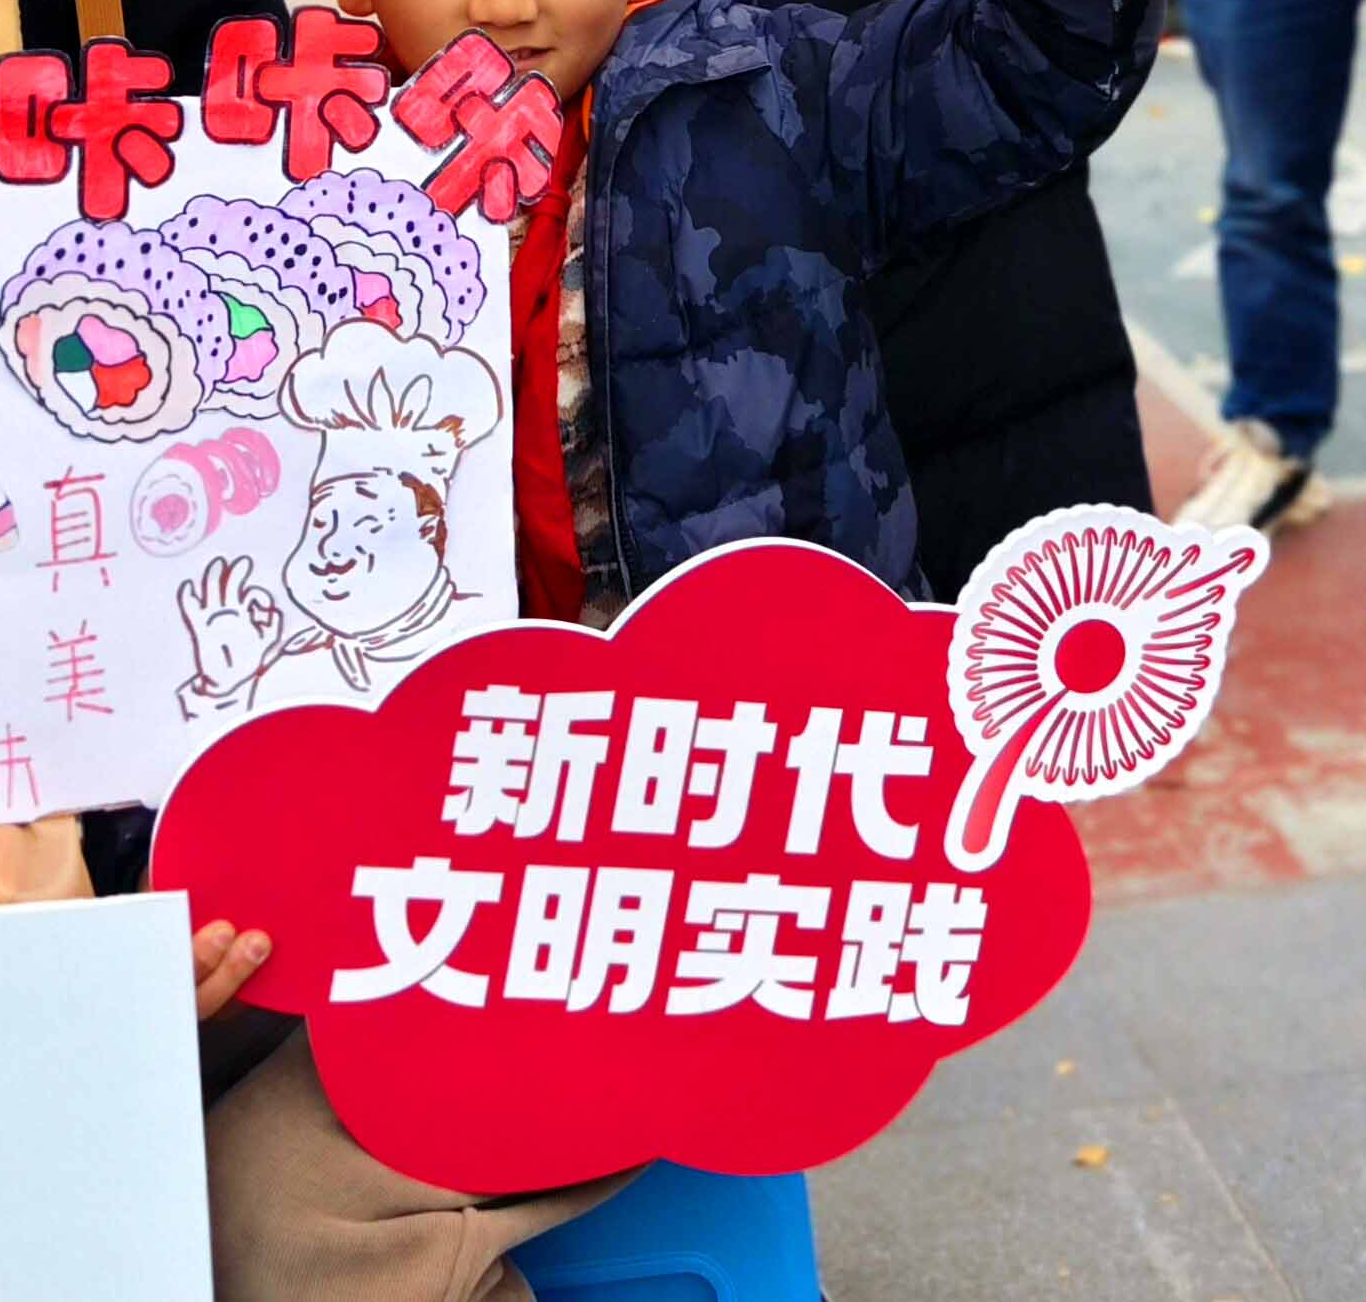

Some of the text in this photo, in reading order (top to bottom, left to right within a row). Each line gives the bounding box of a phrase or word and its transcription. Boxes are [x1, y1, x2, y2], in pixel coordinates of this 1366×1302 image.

[442, 684, 934, 859] 新时代
[329, 857, 988, 1026] 文明实践
